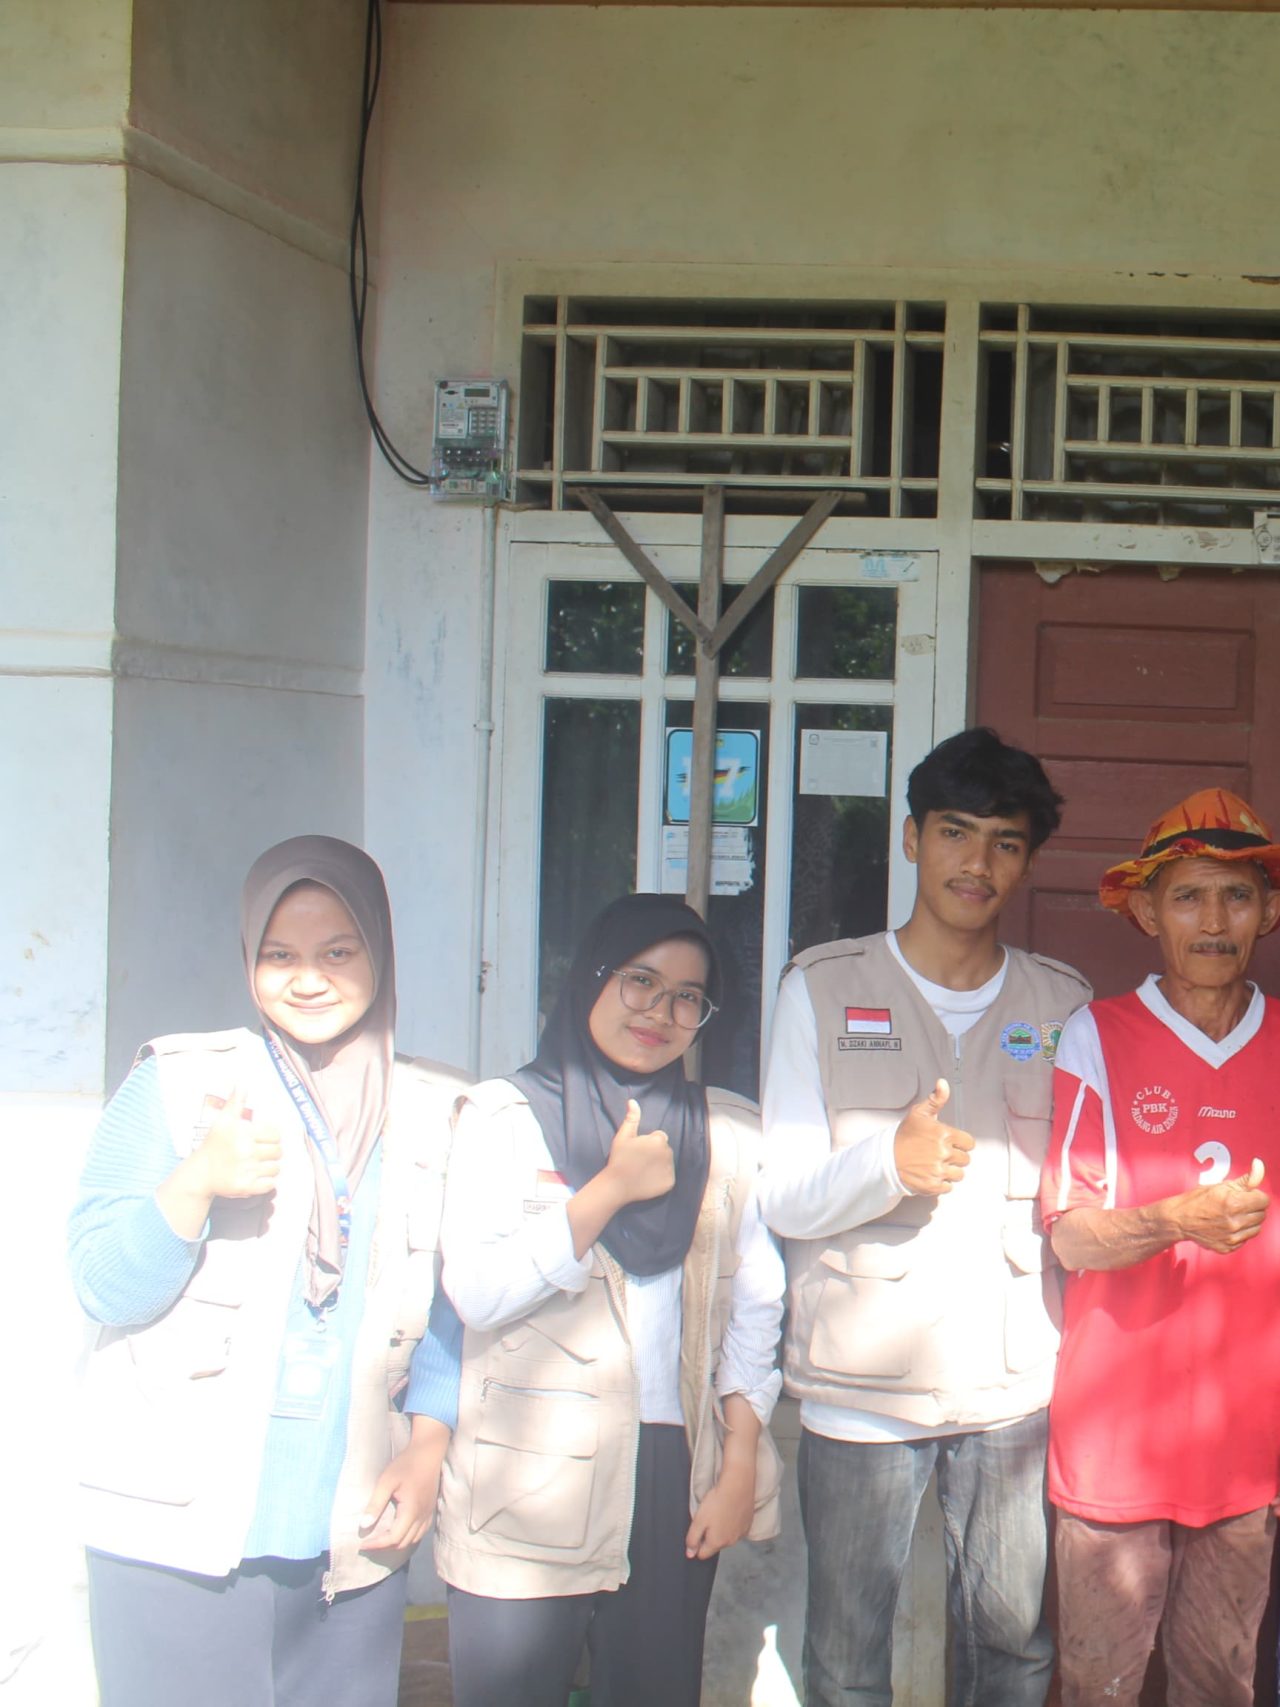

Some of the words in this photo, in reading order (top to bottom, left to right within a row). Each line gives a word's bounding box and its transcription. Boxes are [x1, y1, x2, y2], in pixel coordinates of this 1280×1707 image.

[1136, 1086, 1171, 1100] CLUB
[1142, 1103, 1168, 1113] PBK
[1131, 1107, 1151, 1133] PADANG
[1150, 1123, 1166, 1134] AIR
